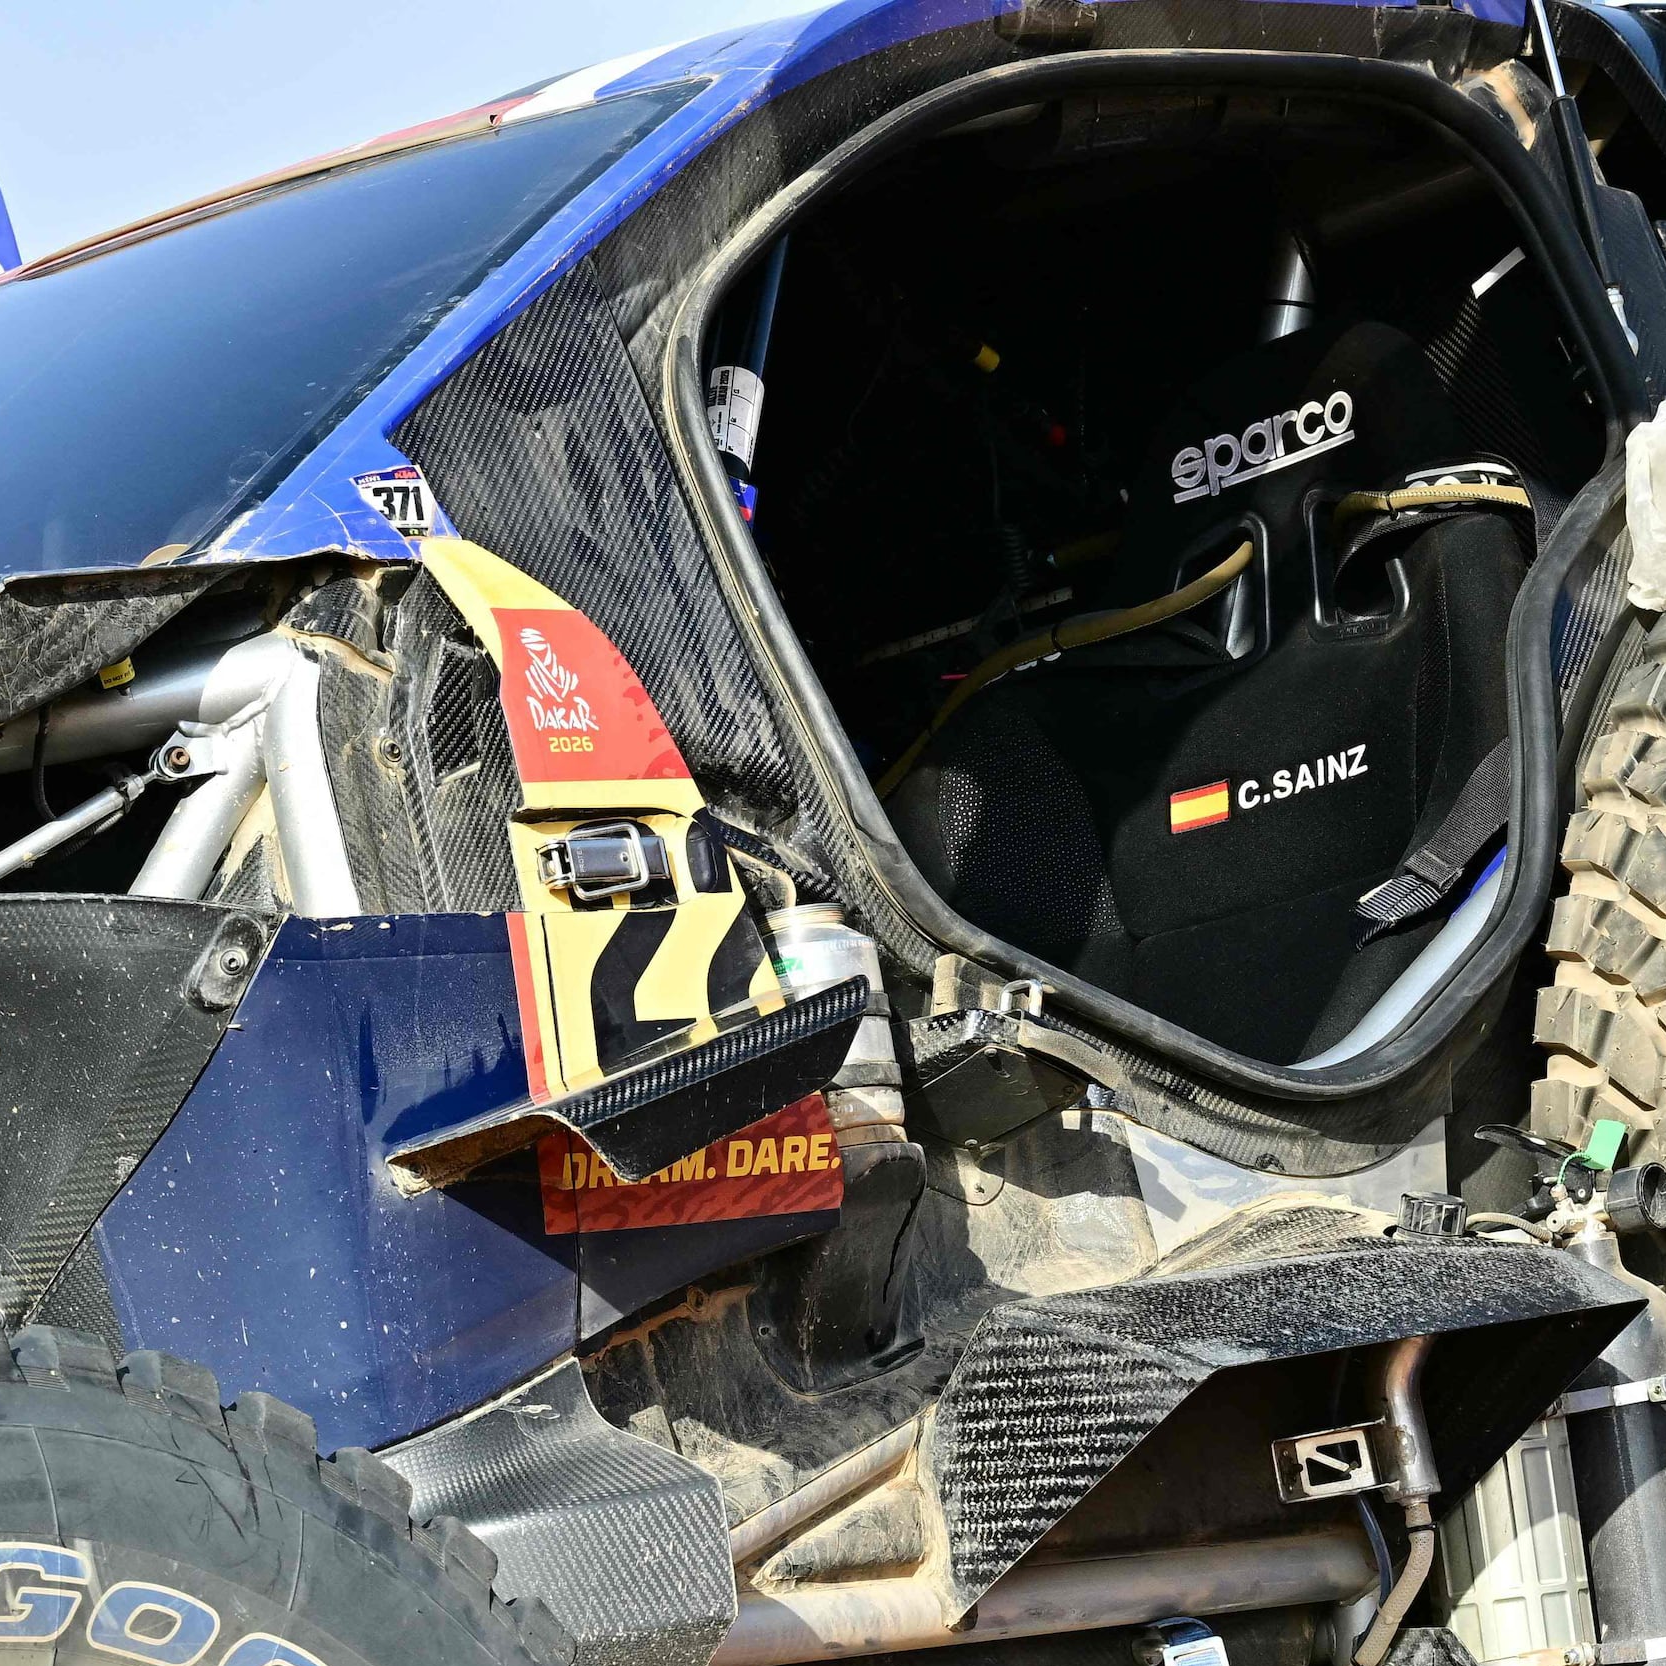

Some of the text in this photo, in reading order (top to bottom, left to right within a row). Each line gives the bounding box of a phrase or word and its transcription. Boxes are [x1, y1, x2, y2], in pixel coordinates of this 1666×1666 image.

[1171, 389, 1356, 504] sparco
[373, 486, 425, 521] 371
[526, 695, 600, 732] DAKAR
[549, 736, 594, 753] 2026
[1237, 741, 1368, 812] C.SAINZ
[726, 1133, 841, 1179] DARE.
